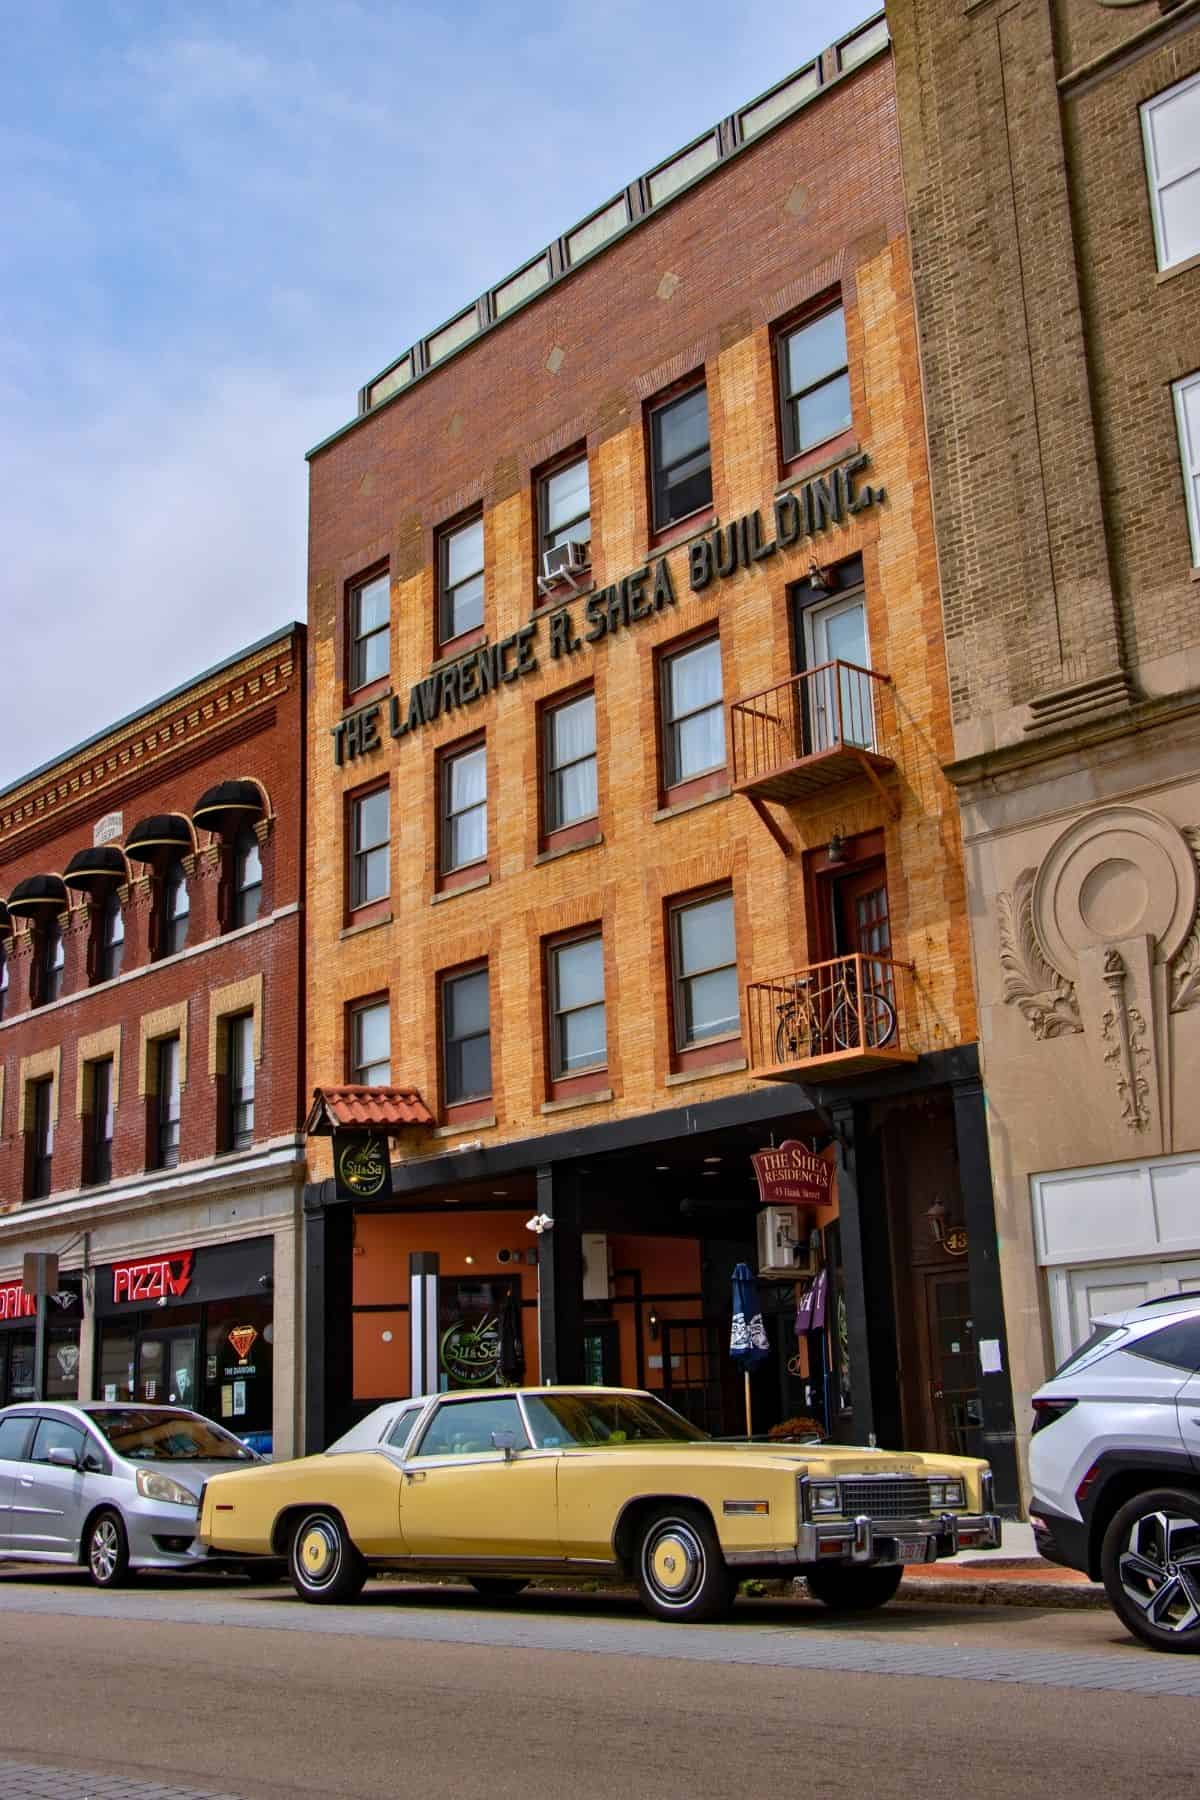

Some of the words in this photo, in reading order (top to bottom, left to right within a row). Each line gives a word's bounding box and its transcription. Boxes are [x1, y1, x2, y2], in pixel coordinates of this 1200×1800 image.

[331, 705, 381, 765] THE
[390, 621, 538, 738] LAWRENCE
[550, 608, 580, 660] R.
[586, 557, 675, 642] SHEA
[761, 1152, 789, 1170] THE
[765, 1169, 828, 1187] RESIDENCES
[947, 1231, 968, 1248] 43
